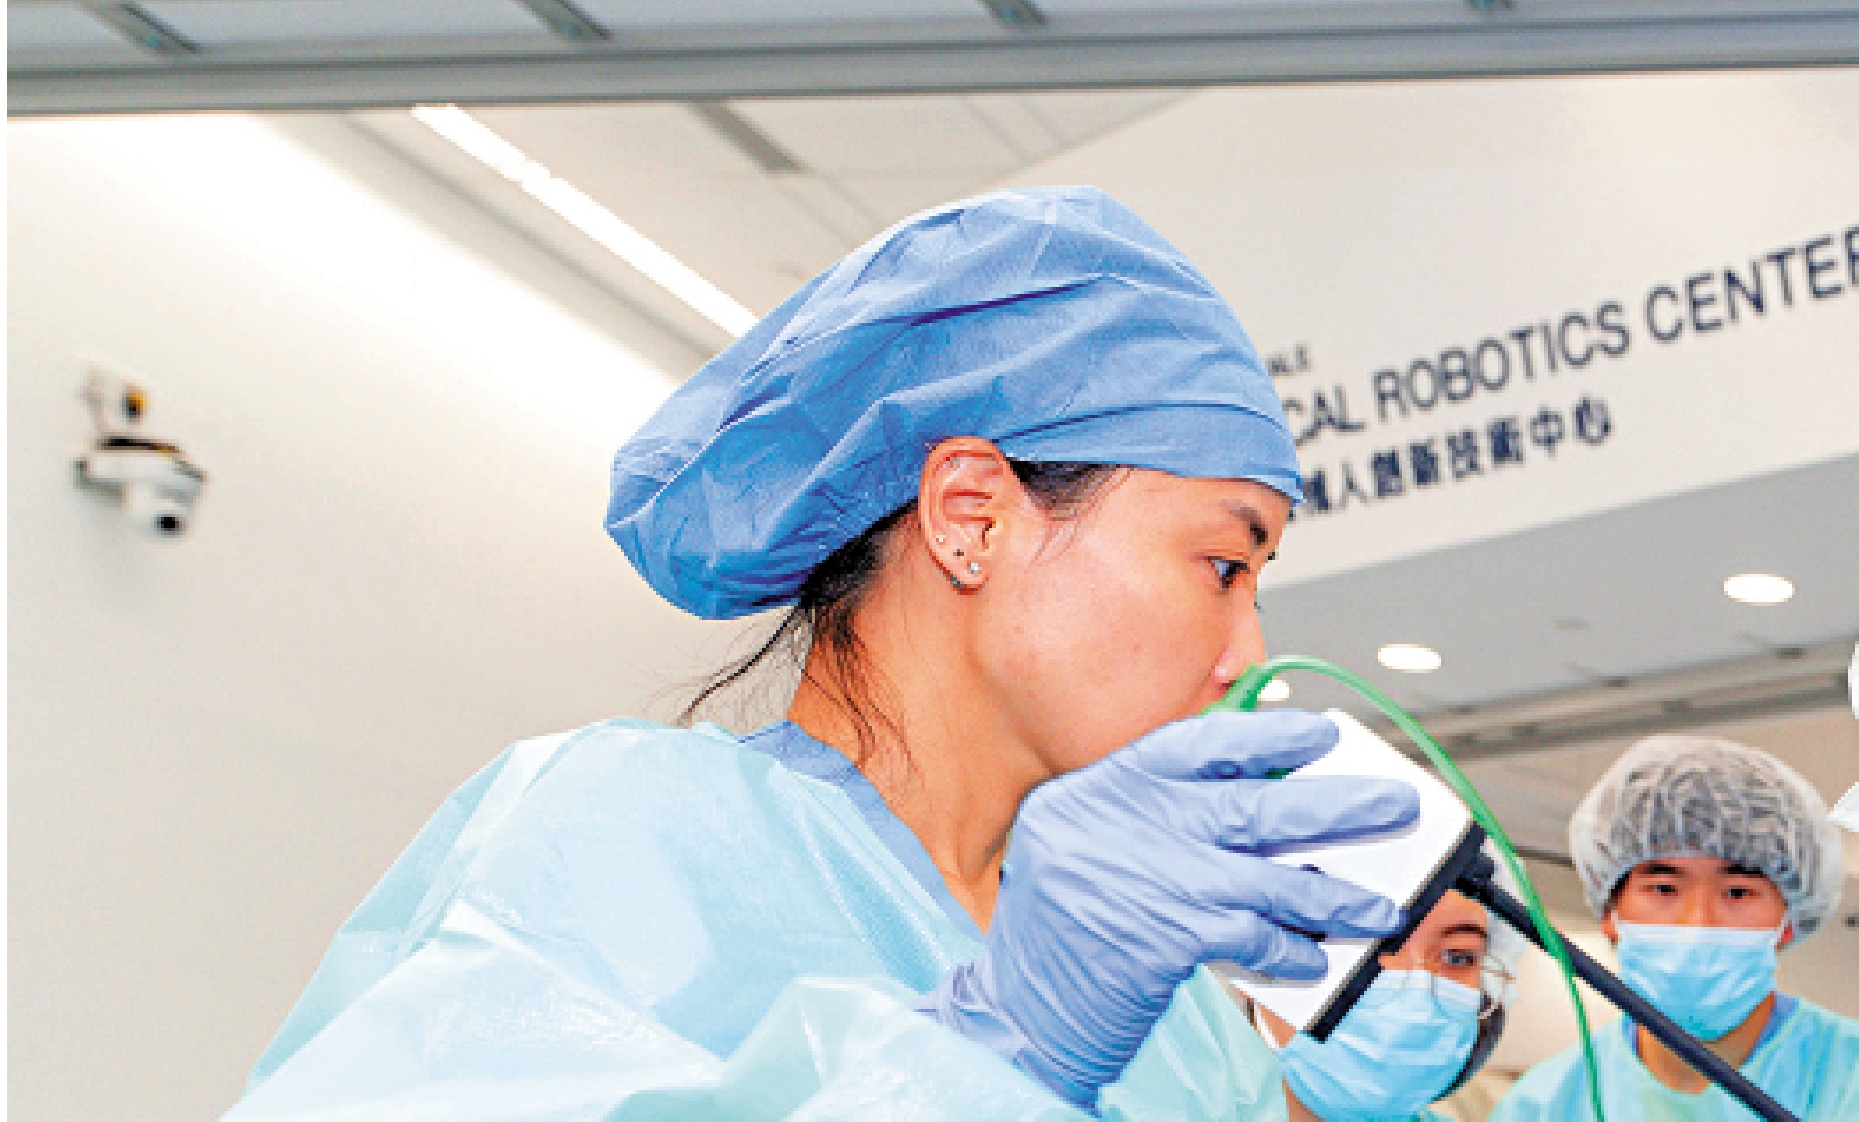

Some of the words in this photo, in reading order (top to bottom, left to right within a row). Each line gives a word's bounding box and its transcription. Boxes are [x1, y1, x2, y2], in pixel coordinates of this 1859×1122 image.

[1372, 300, 1630, 422] ROBOTICS
[1288, 396, 1612, 521] 機人創新技術中心
